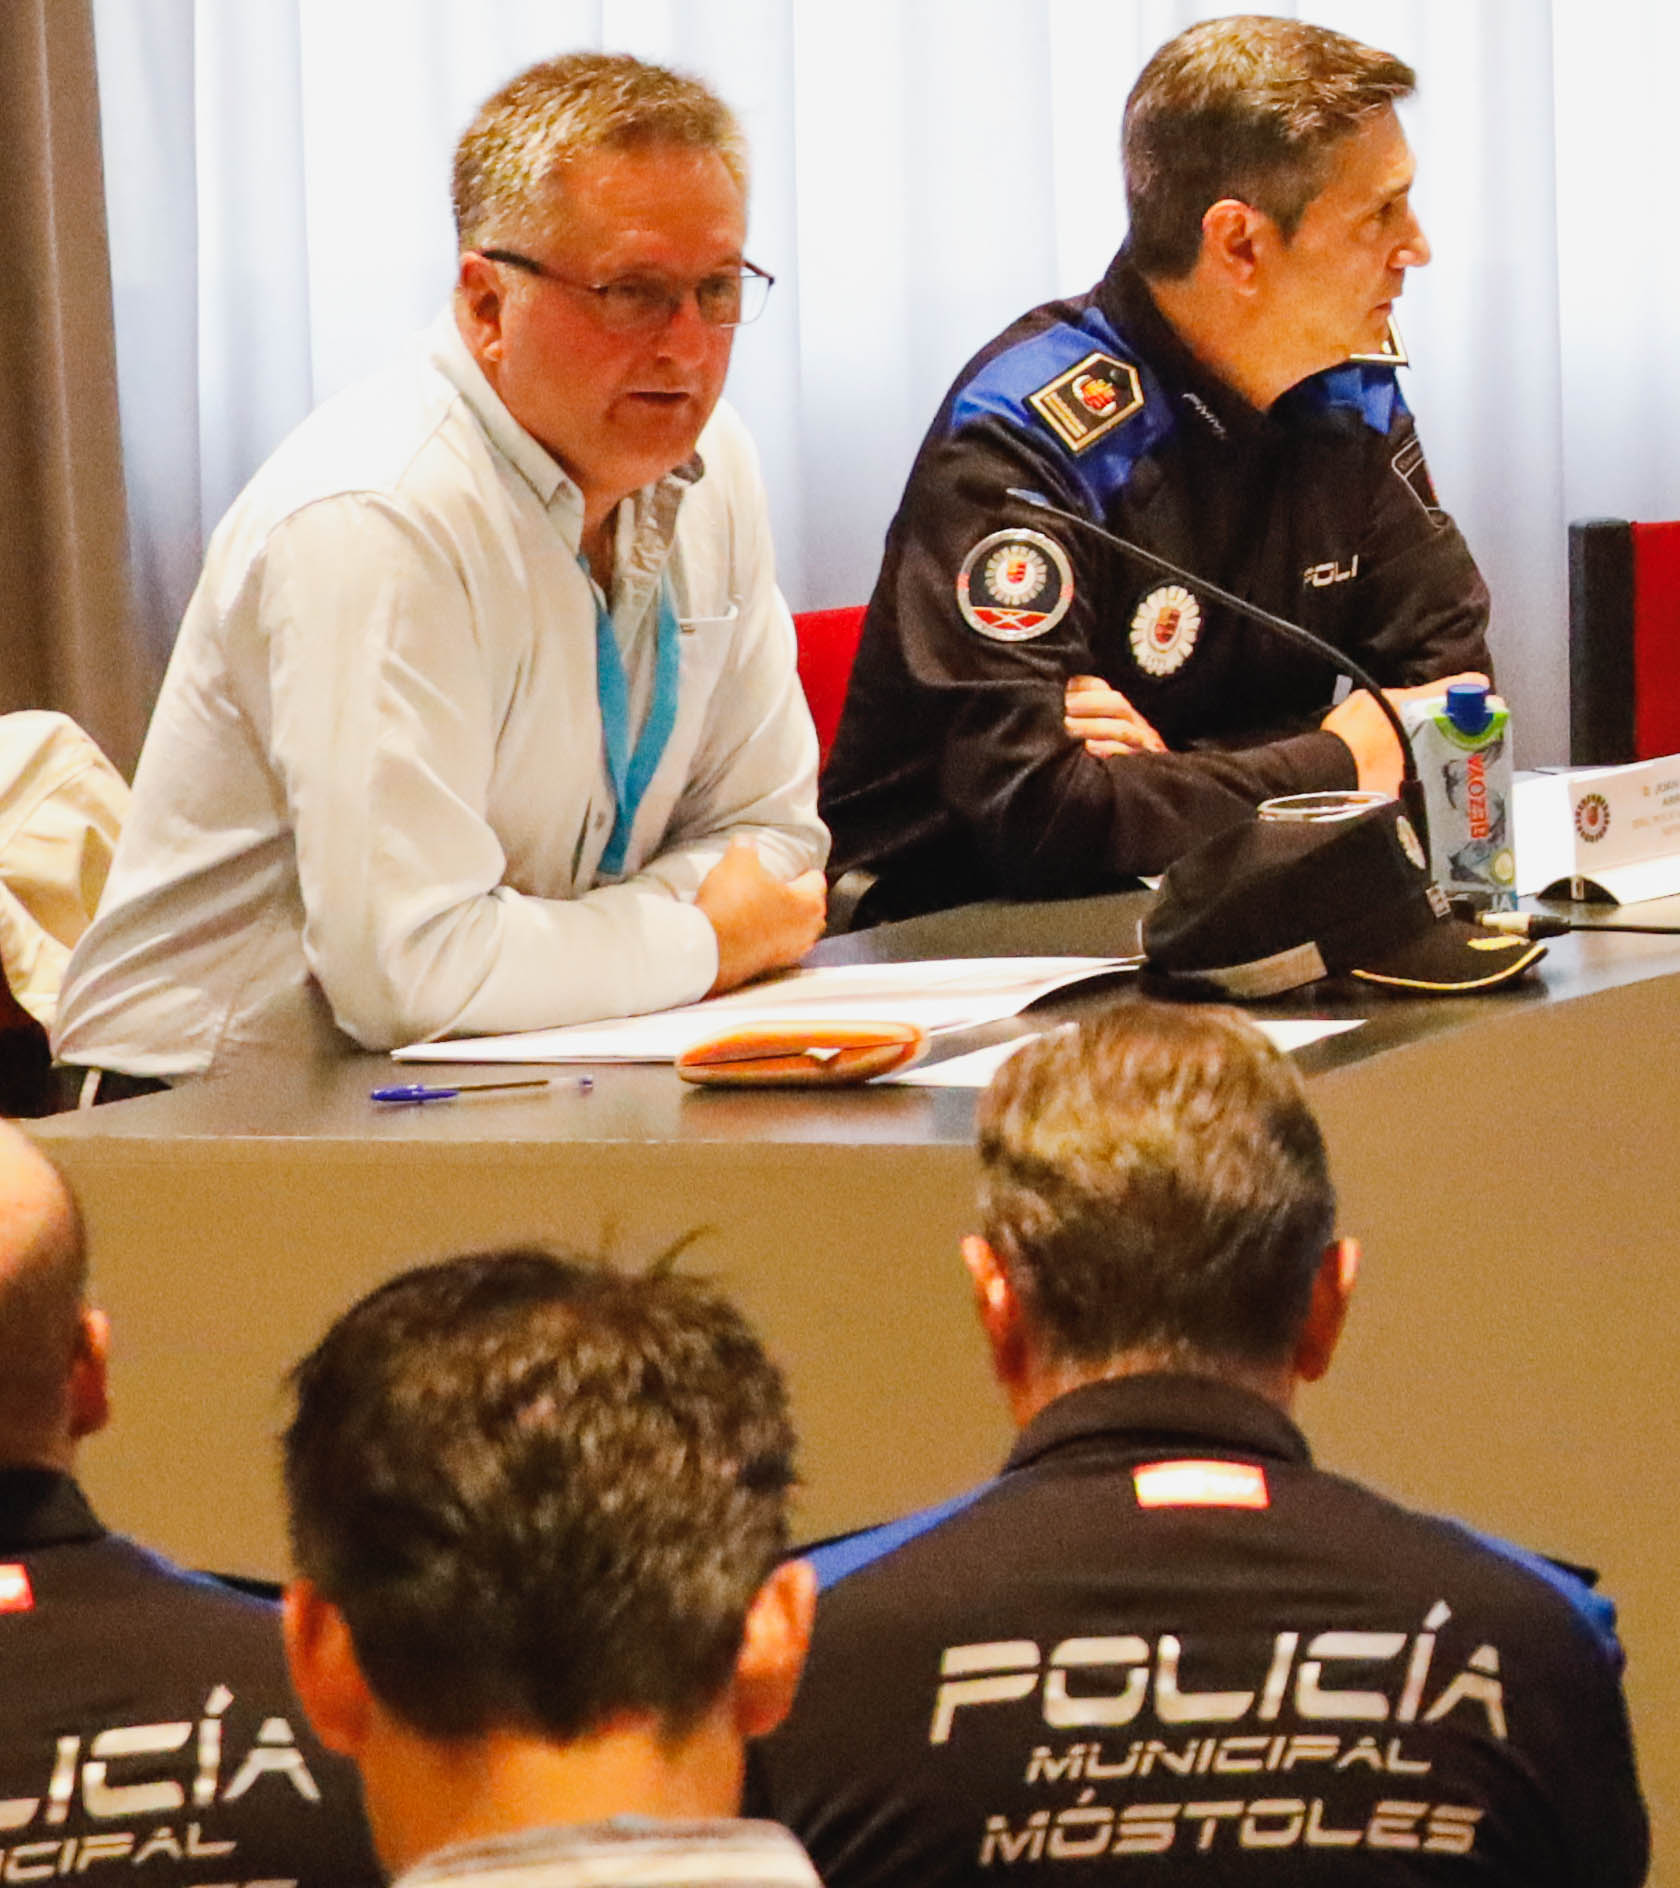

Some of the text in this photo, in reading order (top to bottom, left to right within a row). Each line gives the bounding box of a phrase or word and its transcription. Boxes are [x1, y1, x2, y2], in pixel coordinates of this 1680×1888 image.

[929, 1599, 1508, 1745] POLICÍA
[1026, 1735, 1432, 1784] MUNICIPAL
[978, 1789, 1485, 1867] MÓSTOLES
